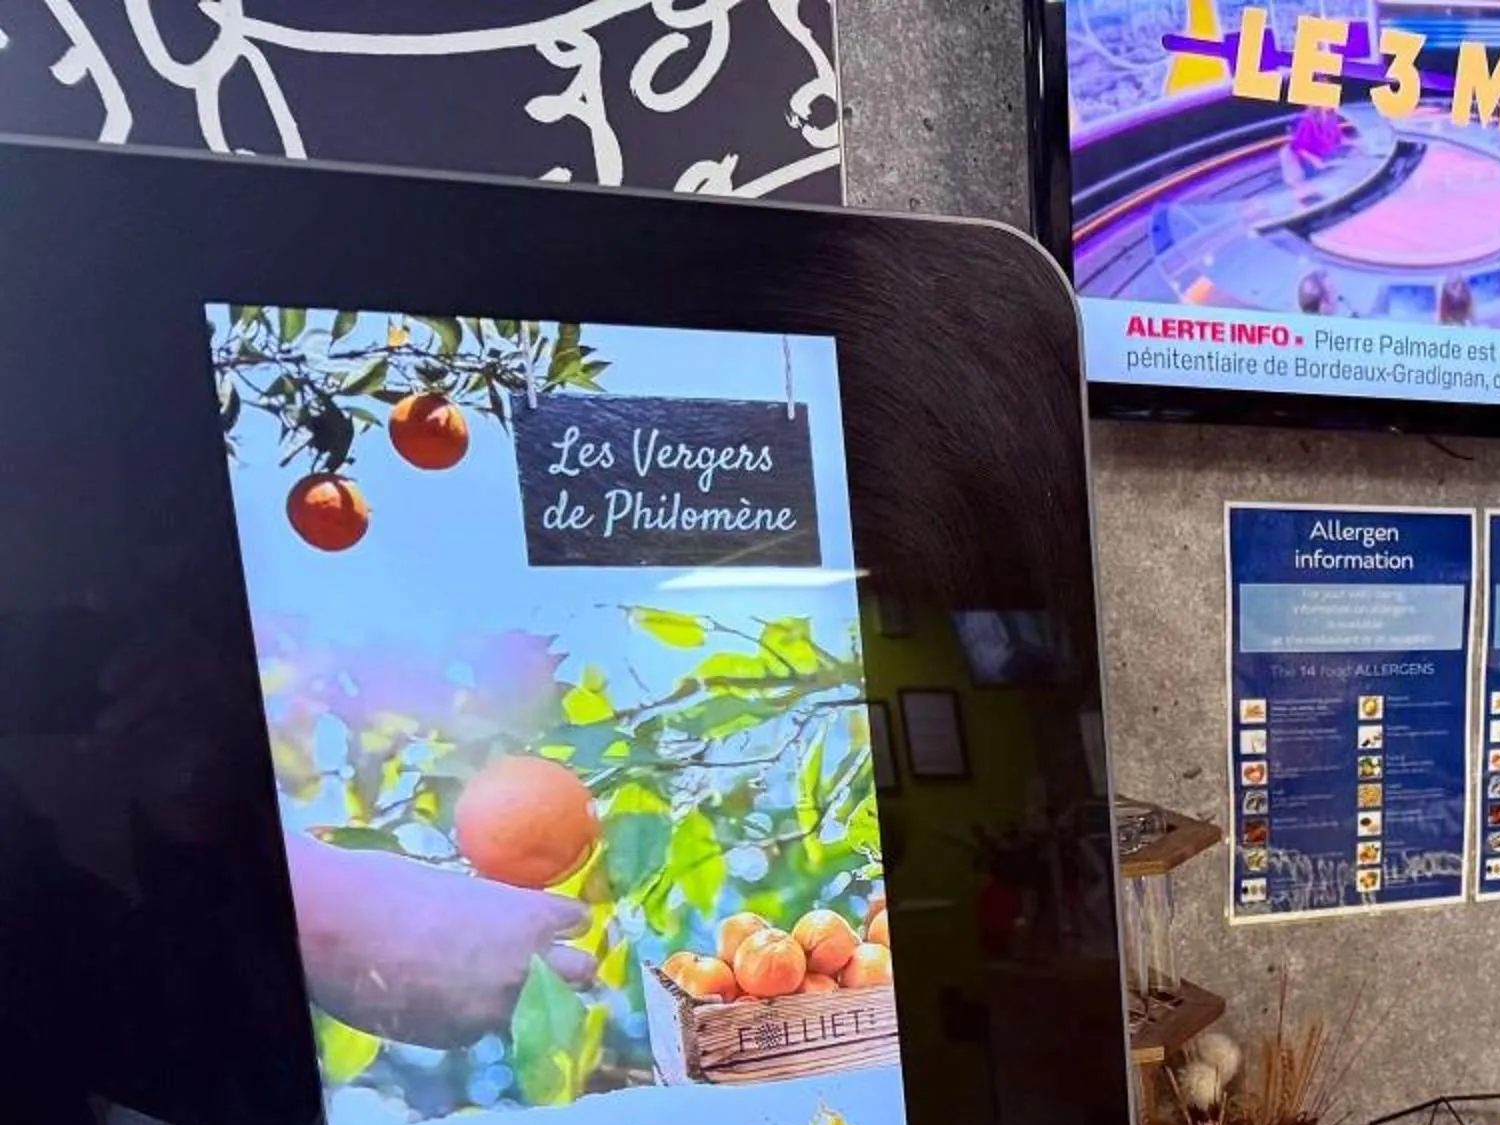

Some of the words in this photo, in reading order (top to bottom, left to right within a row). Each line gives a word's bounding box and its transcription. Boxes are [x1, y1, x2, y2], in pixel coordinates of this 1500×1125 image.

[1232, 7, 1349, 108] LE
[1370, 30, 1427, 118] 3
[1126, 316, 1225, 343] ALERTE
[1230, 323, 1290, 347] INFO
[1314, 329, 1373, 354] Pierre
[1379, 335, 1462, 360] Palmade
[1467, 342, 1496, 363] est
[1126, 346, 1258, 375] pénitentiaire
[1263, 355, 1289, 376] de
[1294, 356, 1489, 391] Bordeaux-Gradignan,
[548, 425, 615, 477] Les
[633, 427, 774, 493] Vergers
[543, 489, 594, 531] de
[602, 488, 797, 538] Philomène
[1309, 519, 1399, 549] Allergen
[1295, 548, 1414, 570] information
[1354, 662, 1436, 678] ALLERGENS
